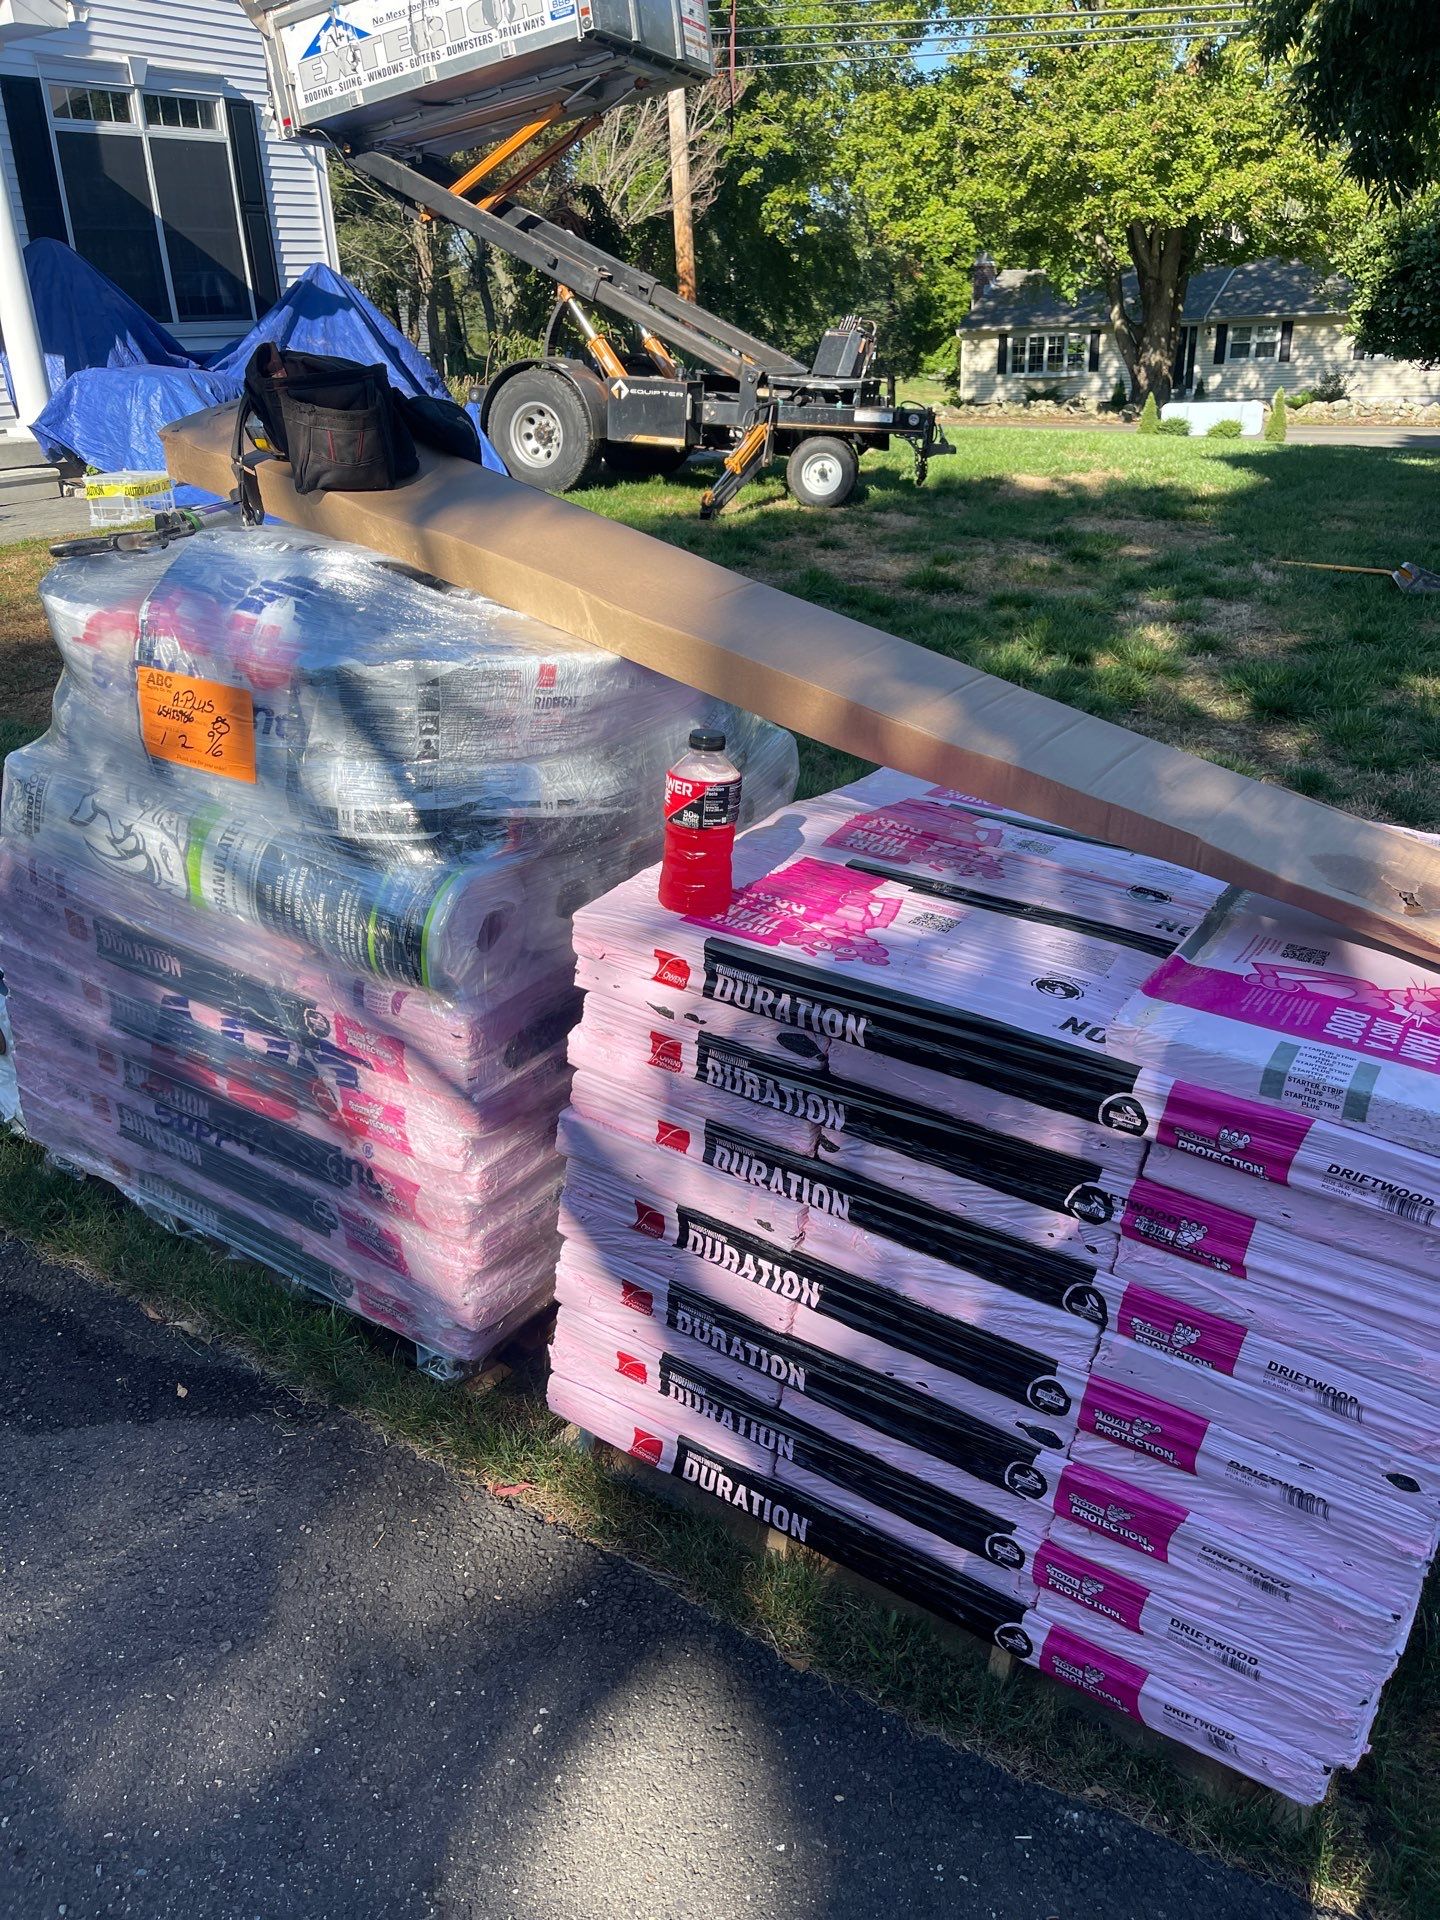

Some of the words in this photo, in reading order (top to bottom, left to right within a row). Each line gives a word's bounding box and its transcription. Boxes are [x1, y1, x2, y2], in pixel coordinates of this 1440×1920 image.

[372, 14, 385, 25] No
[385, 8, 406, 20] Mess
[304, 85, 333, 103] ROOFING
[366, 62, 404, 82] WINDOWS
[446, 33, 494, 57] DUMPSTERS
[522, 16, 546, 32] WAYS
[629, 388, 685, 398] EQUIPTER
[147, 672, 173, 688] ABC
[178, 734, 194, 749] 2
[841, 836, 903, 857] MORE
[850, 830, 910, 848] THAN
[212, 817, 247, 916] GRANULATED
[296, 866, 309, 896] SHAKES
[662, 971, 687, 987] OWENS
[713, 973, 868, 1048] DURATION
[1323, 1006, 1372, 1044] ROOF
[1363, 1039, 1394, 1052] A
[1368, 1016, 1404, 1045] JUST
[705, 1057, 846, 1132] DURATION
[1284, 1090, 1316, 1104] STARTER
[1317, 1099, 1340, 1110] STRIP
[1287, 1076, 1320, 1090] STARTER
[1321, 1085, 1344, 1095] STRIP
[1304, 1087, 1323, 1097] PLUS
[1301, 1101, 1320, 1111] PLUS
[1177, 1139, 1265, 1176] PROTECTION
[713, 1147, 852, 1222] DURATION
[1321, 1184, 1351, 1197] KEARNY
[1326, 1163, 1435, 1207] DRIFTWOOD
[683, 1231, 821, 1309] DURATION
[676, 1310, 806, 1392] DURATION
[1135, 1334, 1213, 1368] PROTECTION
[1138, 1325, 1170, 1343] TOTAL
[669, 1370, 707, 1394] TRUDEFINITION
[1267, 1360, 1358, 1404] DRIFTWOOD
[1095, 1422, 1175, 1461] PROTECTION
[682, 1456, 809, 1543] DURATION
[1071, 1506, 1148, 1545] PROTECTION
[1051, 1567, 1081, 1590] TOTAL
[1048, 1577, 1120, 1619] PROTECTION
[1170, 1617, 1258, 1666] DRIFTWOOD
[1055, 1667, 1122, 1706] PROTECTION
[1164, 1703, 1236, 1741] DRIFTWOOD
